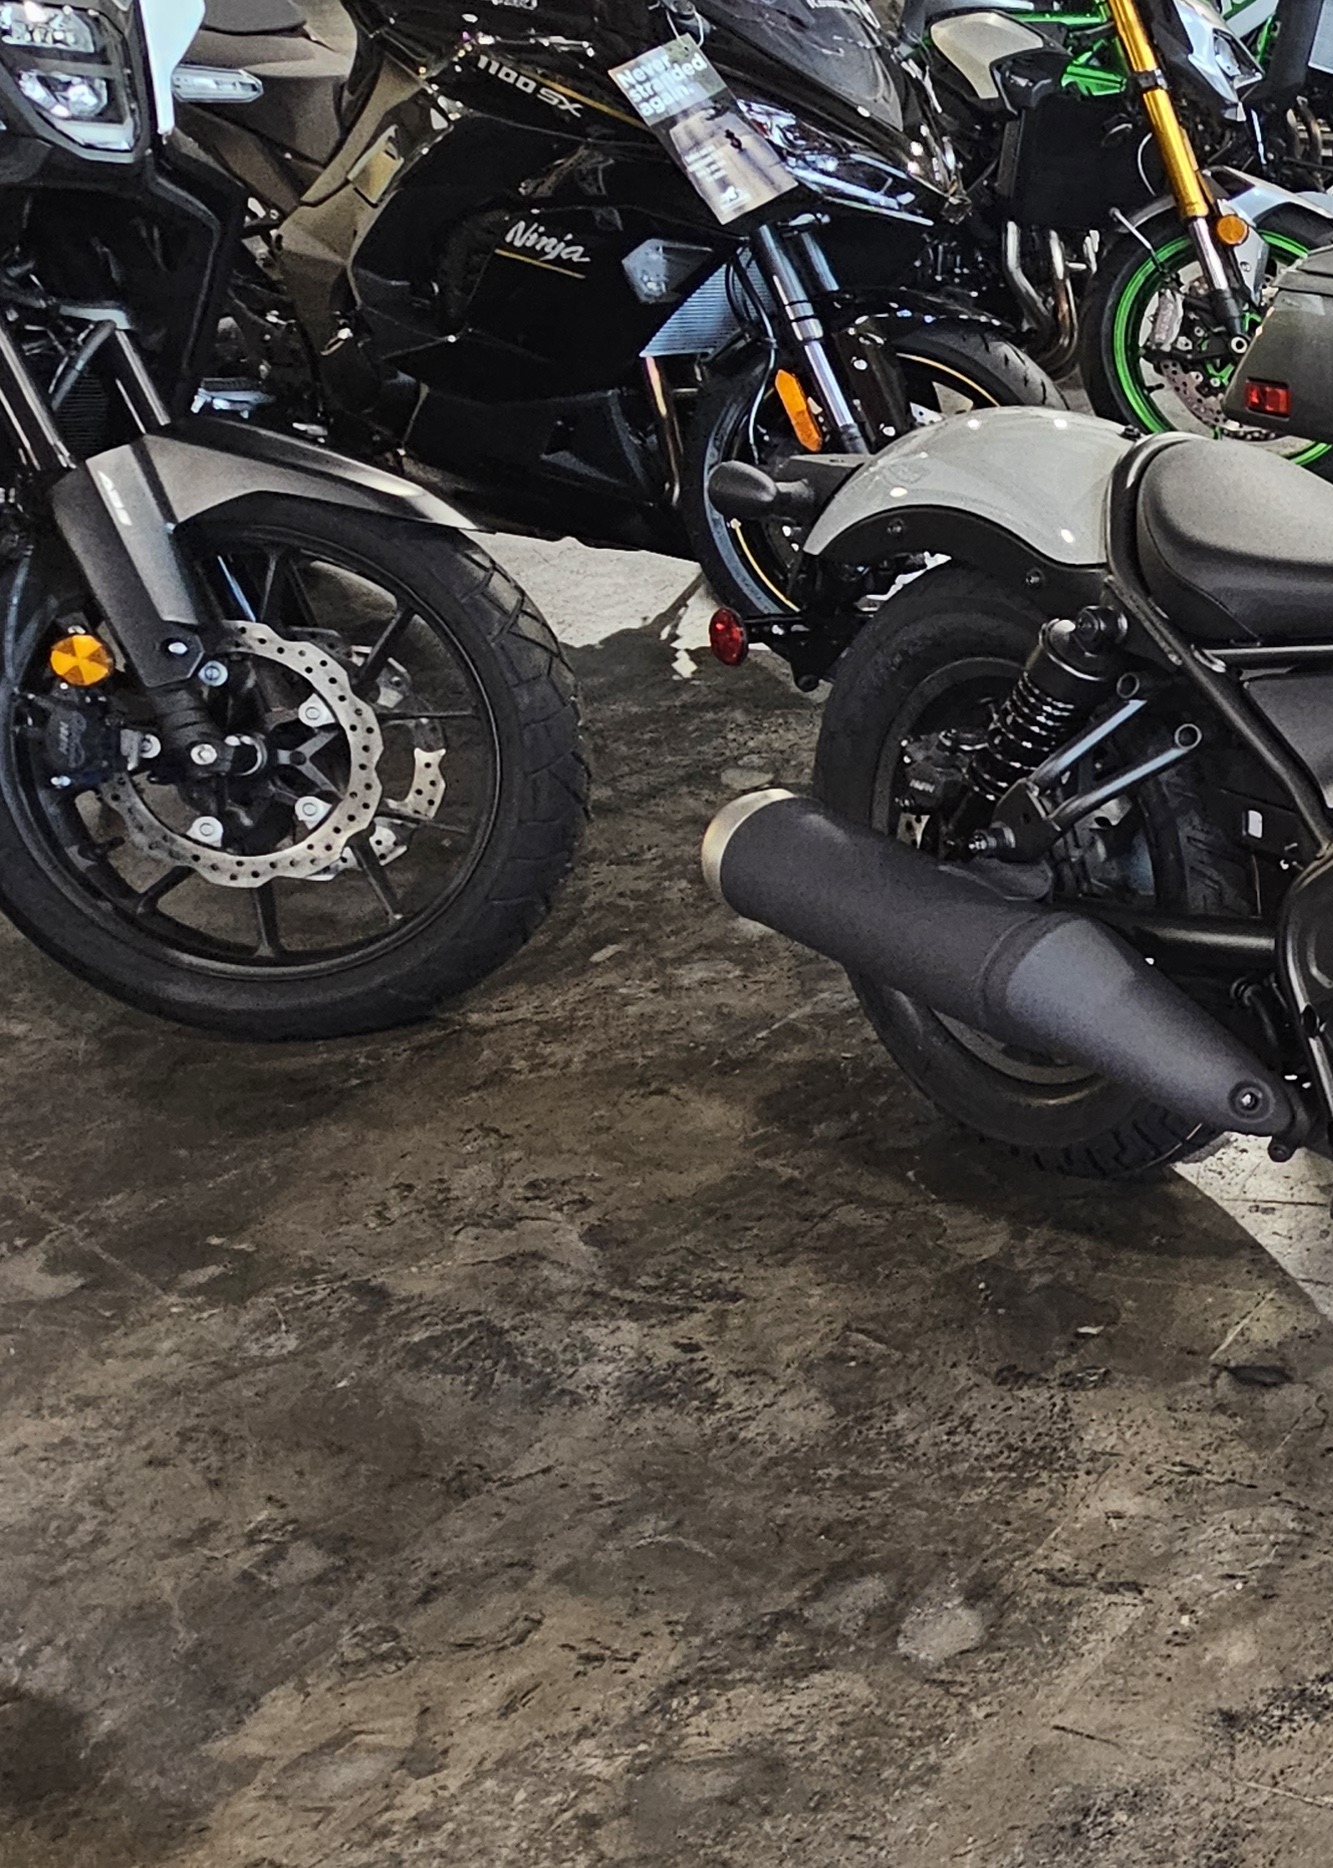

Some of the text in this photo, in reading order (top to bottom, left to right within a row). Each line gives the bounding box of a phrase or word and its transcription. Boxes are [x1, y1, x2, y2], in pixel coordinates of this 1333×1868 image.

[477, 54, 584, 118] 1100 SX
[616, 55, 672, 89] Never
[629, 52, 708, 103] stranded
[638, 85, 695, 117] again.
[504, 220, 591, 262] Ninja
